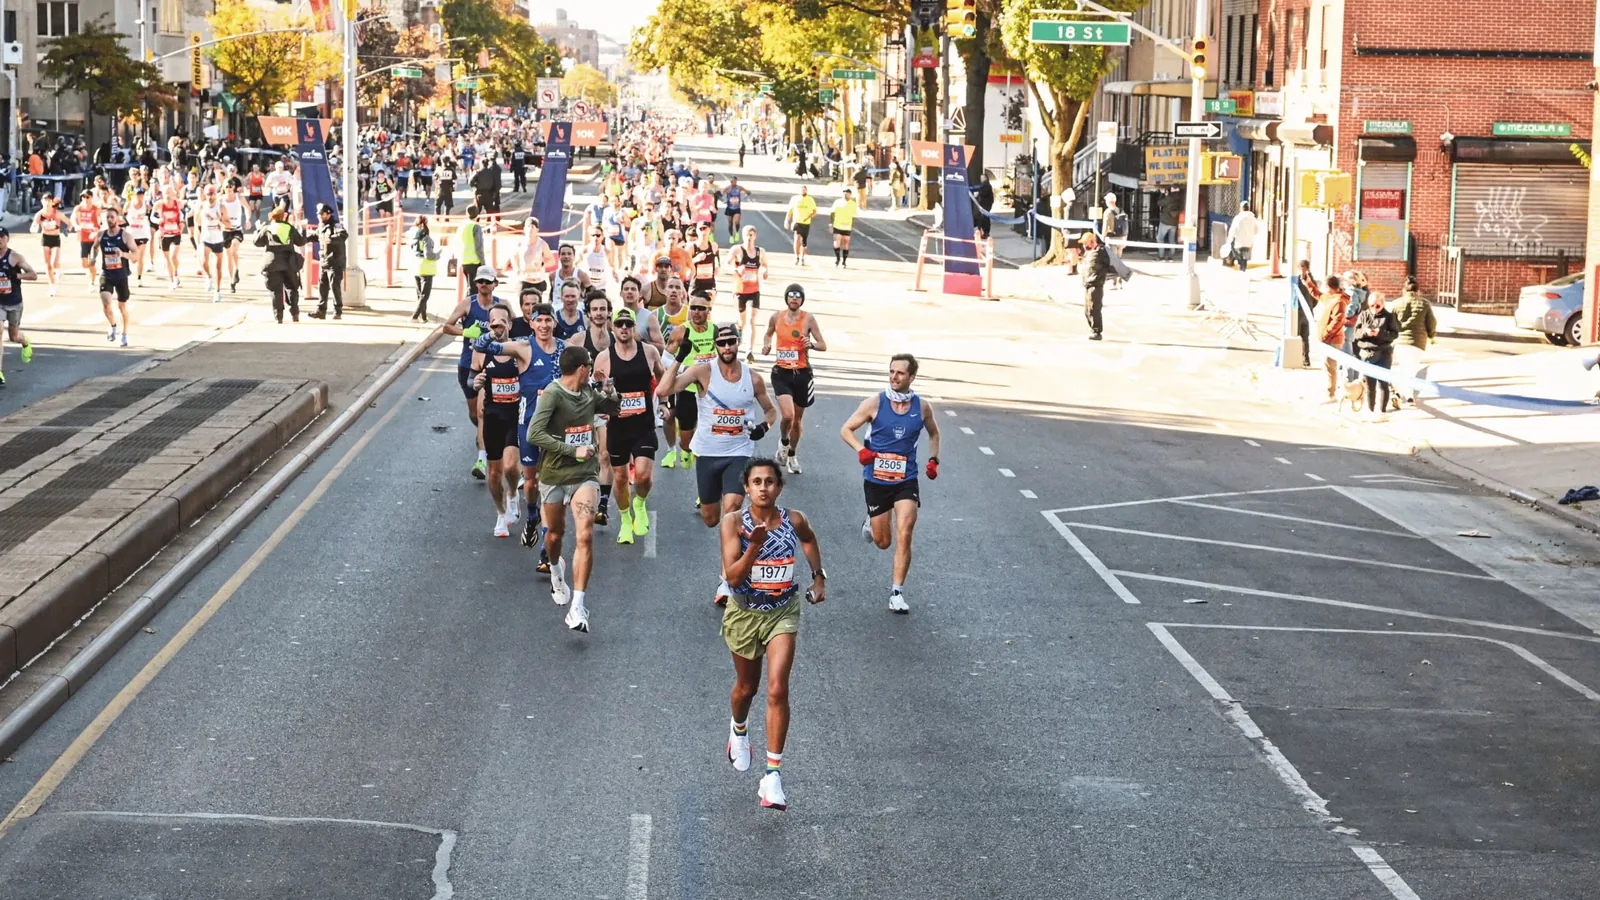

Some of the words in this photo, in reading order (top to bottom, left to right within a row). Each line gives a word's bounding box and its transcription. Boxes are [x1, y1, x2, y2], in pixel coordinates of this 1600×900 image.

[1058, 26, 1076, 39] 18
[1083, 27, 1104, 41] St
[1211, 101, 1220, 111] 18
[271, 126, 293, 136] 10K
[1507, 124, 1556, 133] MEZQUILA
[576, 130, 595, 139] 10K
[920, 150, 939, 159] 10K
[1153, 149, 1173, 158] FLAT
[1149, 162, 1160, 170] WE
[496, 384, 516, 393] 2196
[621, 398, 641, 408] 2025
[717, 415, 740, 425] 2066
[570, 433, 589, 444] 2464
[879, 459, 902, 470] 2505
[759, 566, 787, 579] 1977
